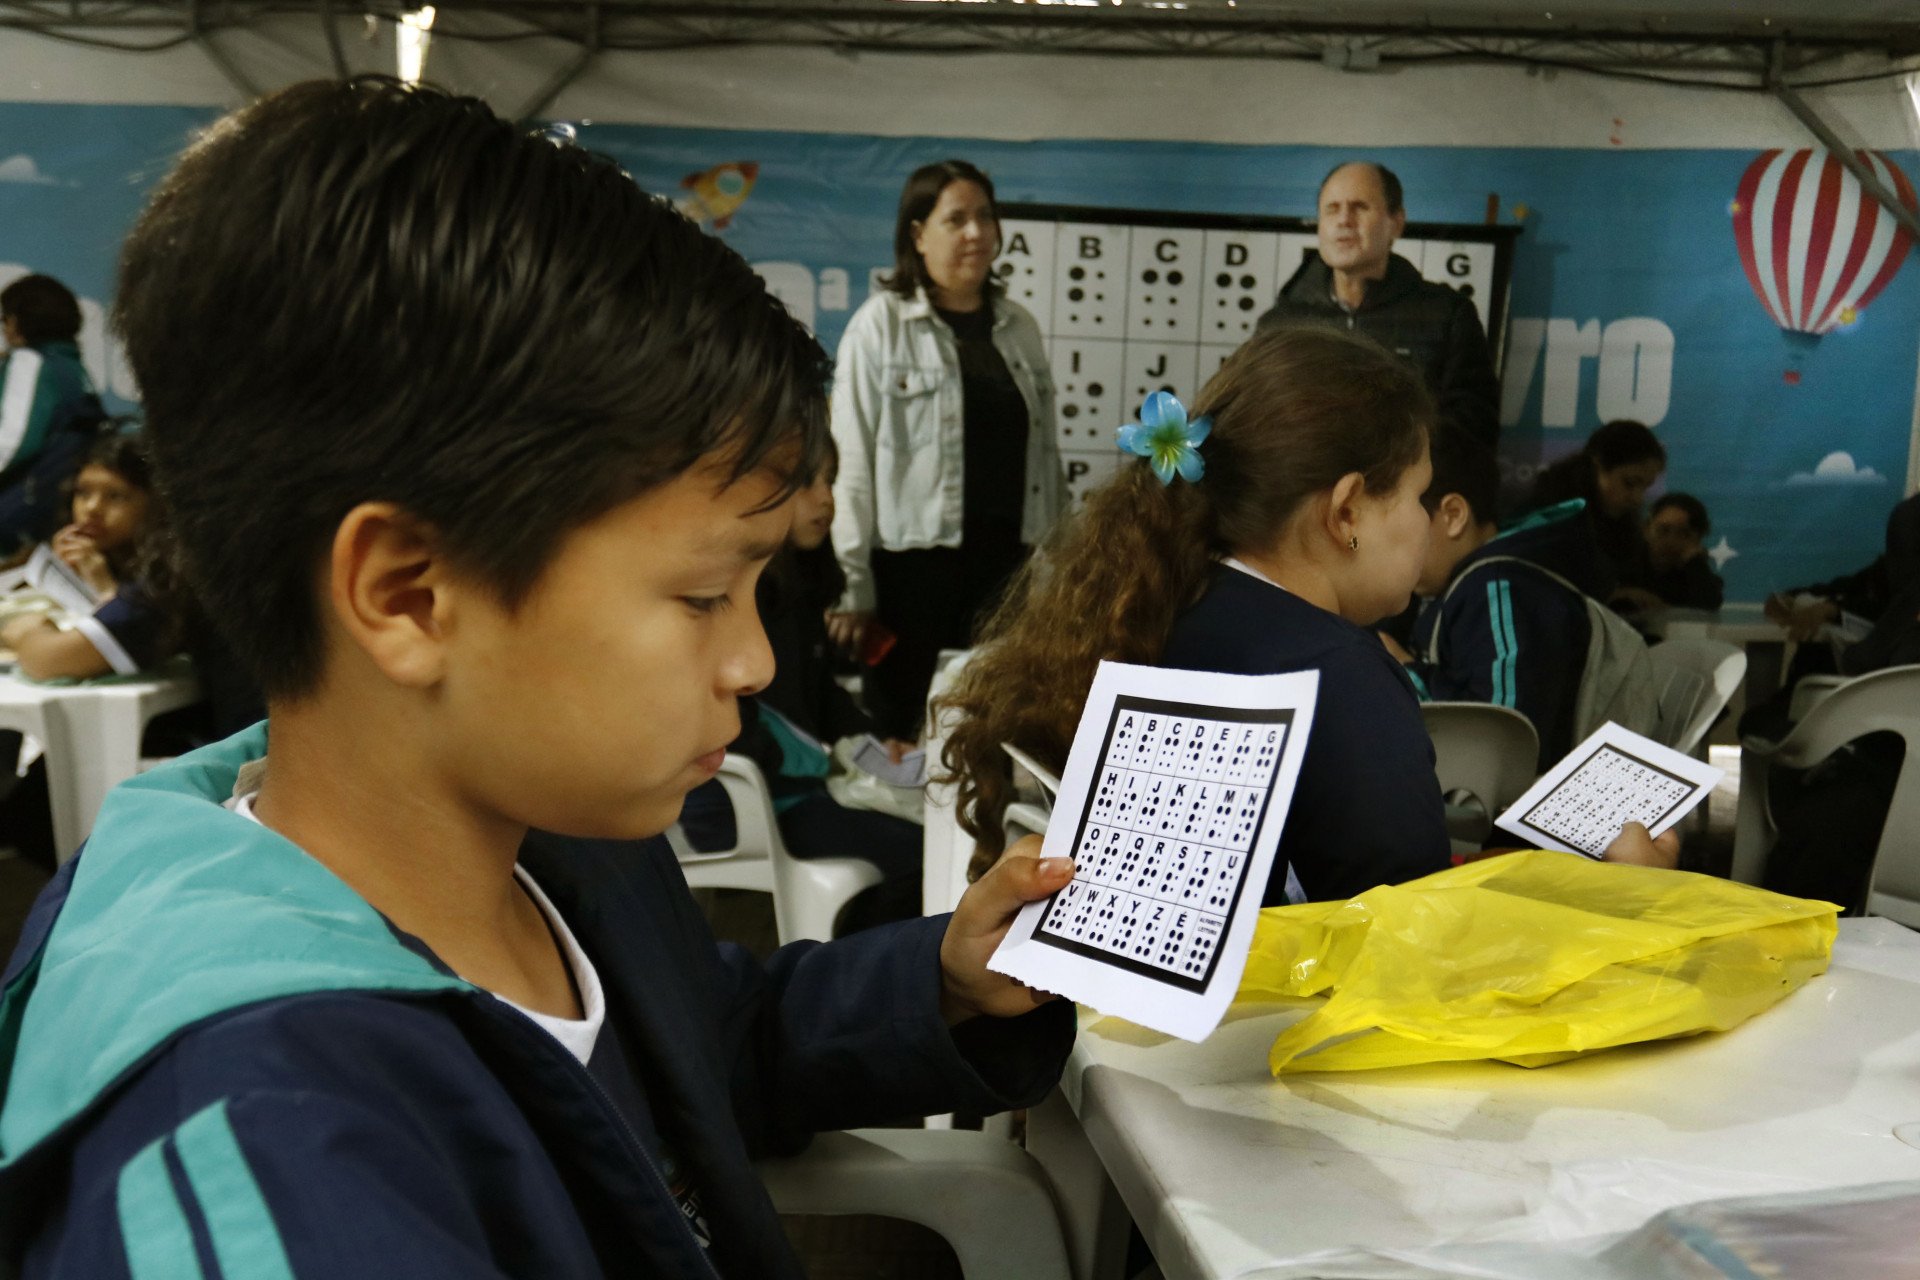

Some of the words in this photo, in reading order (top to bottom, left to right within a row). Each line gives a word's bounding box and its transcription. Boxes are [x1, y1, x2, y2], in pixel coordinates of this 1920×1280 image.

[1007, 233, 1030, 255] A
[1080, 237, 1101, 259] B
[1155, 239, 1178, 263] C
[1225, 244, 1248, 266] D
[1446, 254, 1470, 277] G
[1072, 352, 1080, 373] I
[1146, 355, 1167, 378] J
[1067, 461, 1090, 483] P
[1124, 716, 1132, 728] A
[1148, 720, 1157, 731] B
[1173, 723, 1181, 735] C
[1195, 726, 1204, 737] D
[1220, 728, 1230, 740] E
[1244, 730, 1252, 742] F
[1267, 731, 1276, 743] G
[1107, 773, 1117, 785] H
[1129, 777, 1134, 788] I
[1153, 781, 1161, 793] J
[1176, 784, 1186, 796] K
[1200, 787, 1207, 799] L
[1224, 790, 1235, 802] M
[1248, 793, 1258, 805] N
[1091, 829, 1100, 840] O
[1111, 833, 1120, 844] P
[1135, 838, 1144, 850] Q
[1155, 842, 1165, 854] R
[1179, 846, 1188, 858] S
[1203, 851, 1212, 863] T
[1228, 856, 1238, 869] U
[1069, 885, 1078, 897] V
[1087, 890, 1099, 902] W
[1107, 895, 1118, 907] X
[1132, 901, 1141, 913] Y
[1153, 907, 1164, 920] Z
[1177, 911, 1187, 928] É
